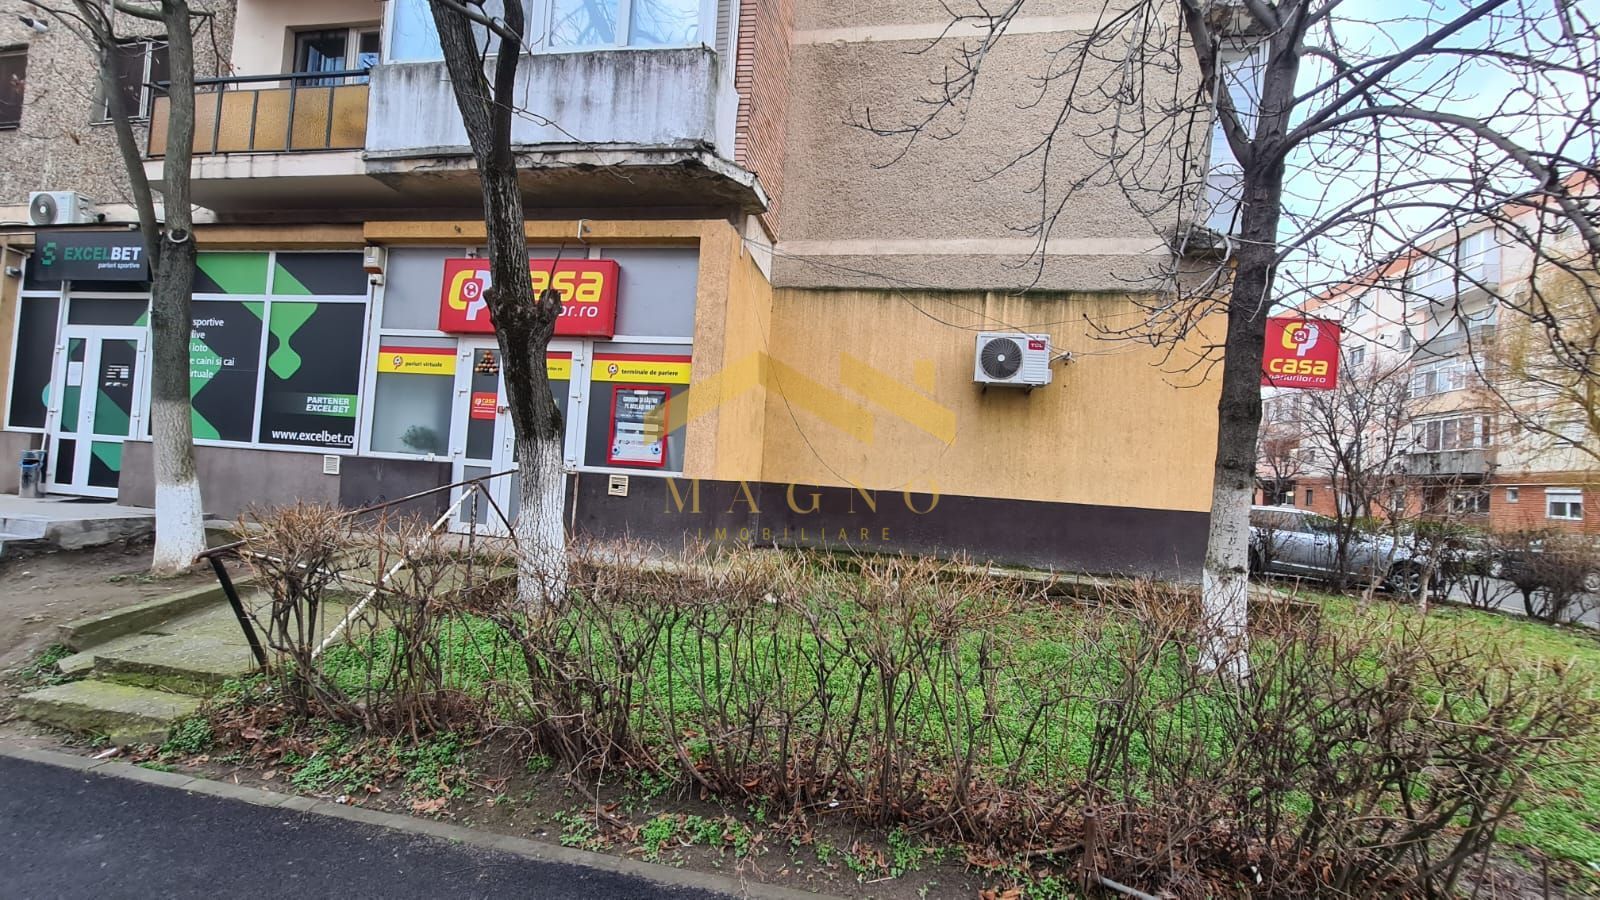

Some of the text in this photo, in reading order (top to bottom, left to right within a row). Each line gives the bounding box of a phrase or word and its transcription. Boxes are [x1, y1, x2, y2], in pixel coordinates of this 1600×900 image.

[63, 246, 142, 261] EXCELBET
[529, 270, 604, 303] asa
[192, 318, 225, 328] sportive
[223, 357, 235, 366] cai
[1269, 358, 1328, 375] casa
[306, 396, 350, 405] PARTENER
[305, 404, 350, 413] EXCELBET
[271, 430, 354, 443] www.excelbet.ro
